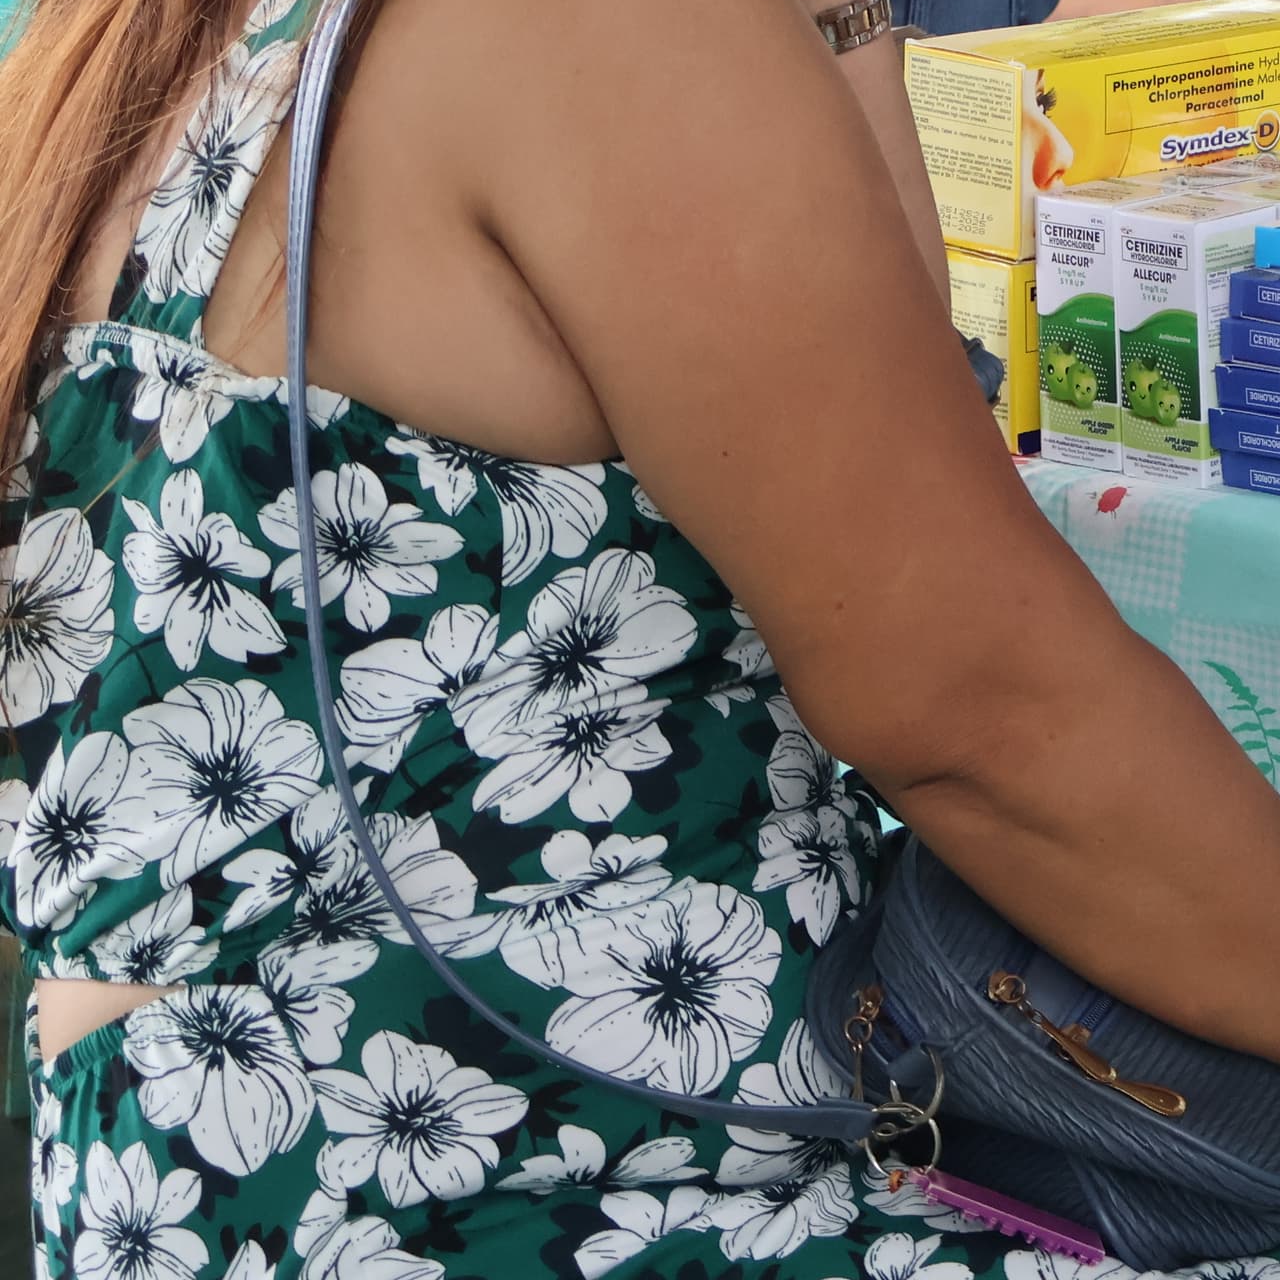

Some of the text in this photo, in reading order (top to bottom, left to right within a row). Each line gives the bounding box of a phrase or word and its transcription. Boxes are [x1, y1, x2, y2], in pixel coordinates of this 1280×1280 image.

[1112, 61, 1254, 92] Phenylpropanolamine
[1149, 77, 1254, 103] Chlorphenamine
[1186, 90, 1264, 113] Paracetamol
[1161, 121, 1275, 161] Symdex-D
[1044, 224, 1100, 243] CETIRIZINE
[1049, 238, 1095, 251] HYDROCHLORIDE
[1126, 240, 1182, 258] CETIRIZINE
[1131, 252, 1177, 266] HYDROCHLORIDE
[1060, 277, 1084, 287] SYRUP
[1142, 294, 1167, 303] SYRUP
